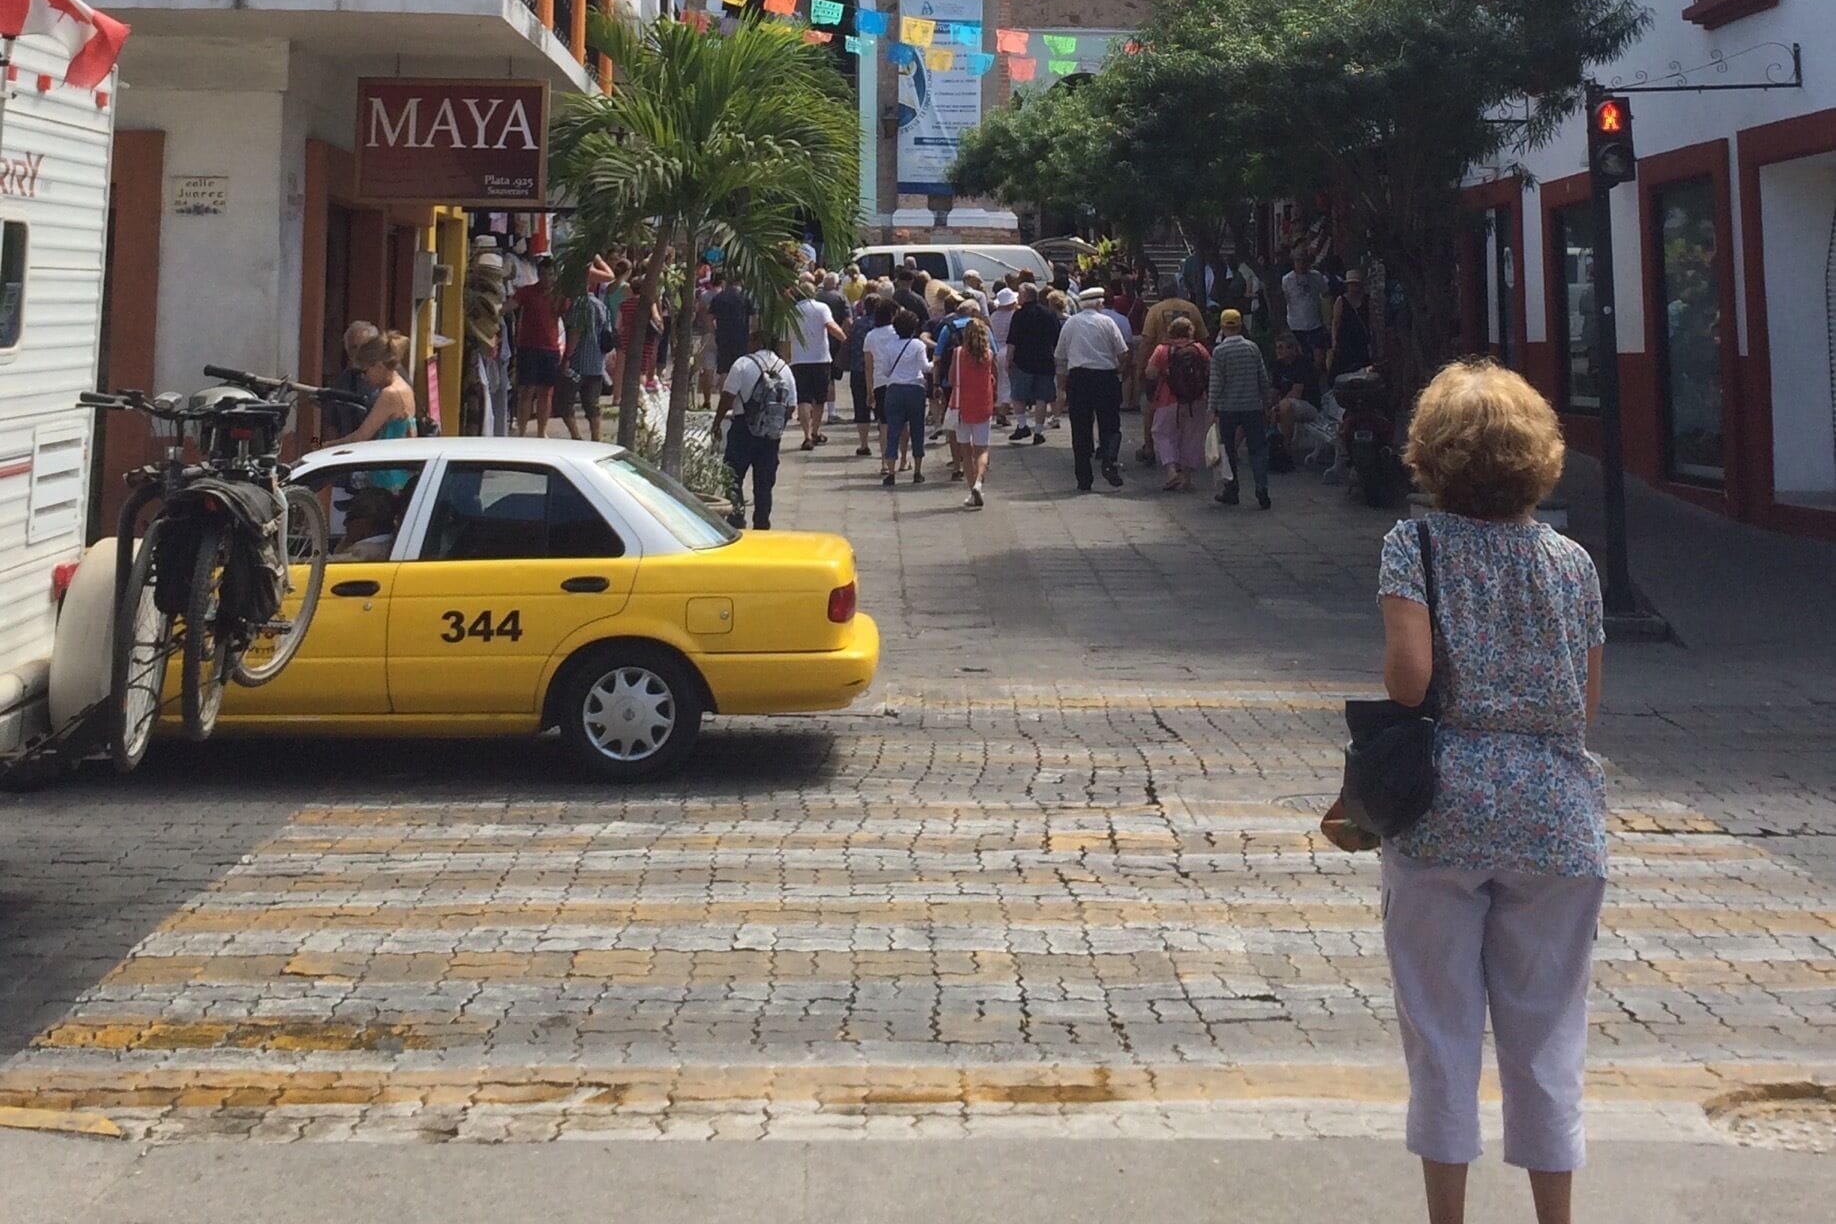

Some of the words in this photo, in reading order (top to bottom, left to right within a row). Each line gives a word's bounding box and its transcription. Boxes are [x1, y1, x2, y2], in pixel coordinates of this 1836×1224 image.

[366, 97, 539, 150] MAYA
[484, 175, 510, 186] Plata
[512, 176, 534, 189] .925
[440, 609, 523, 644] 344
